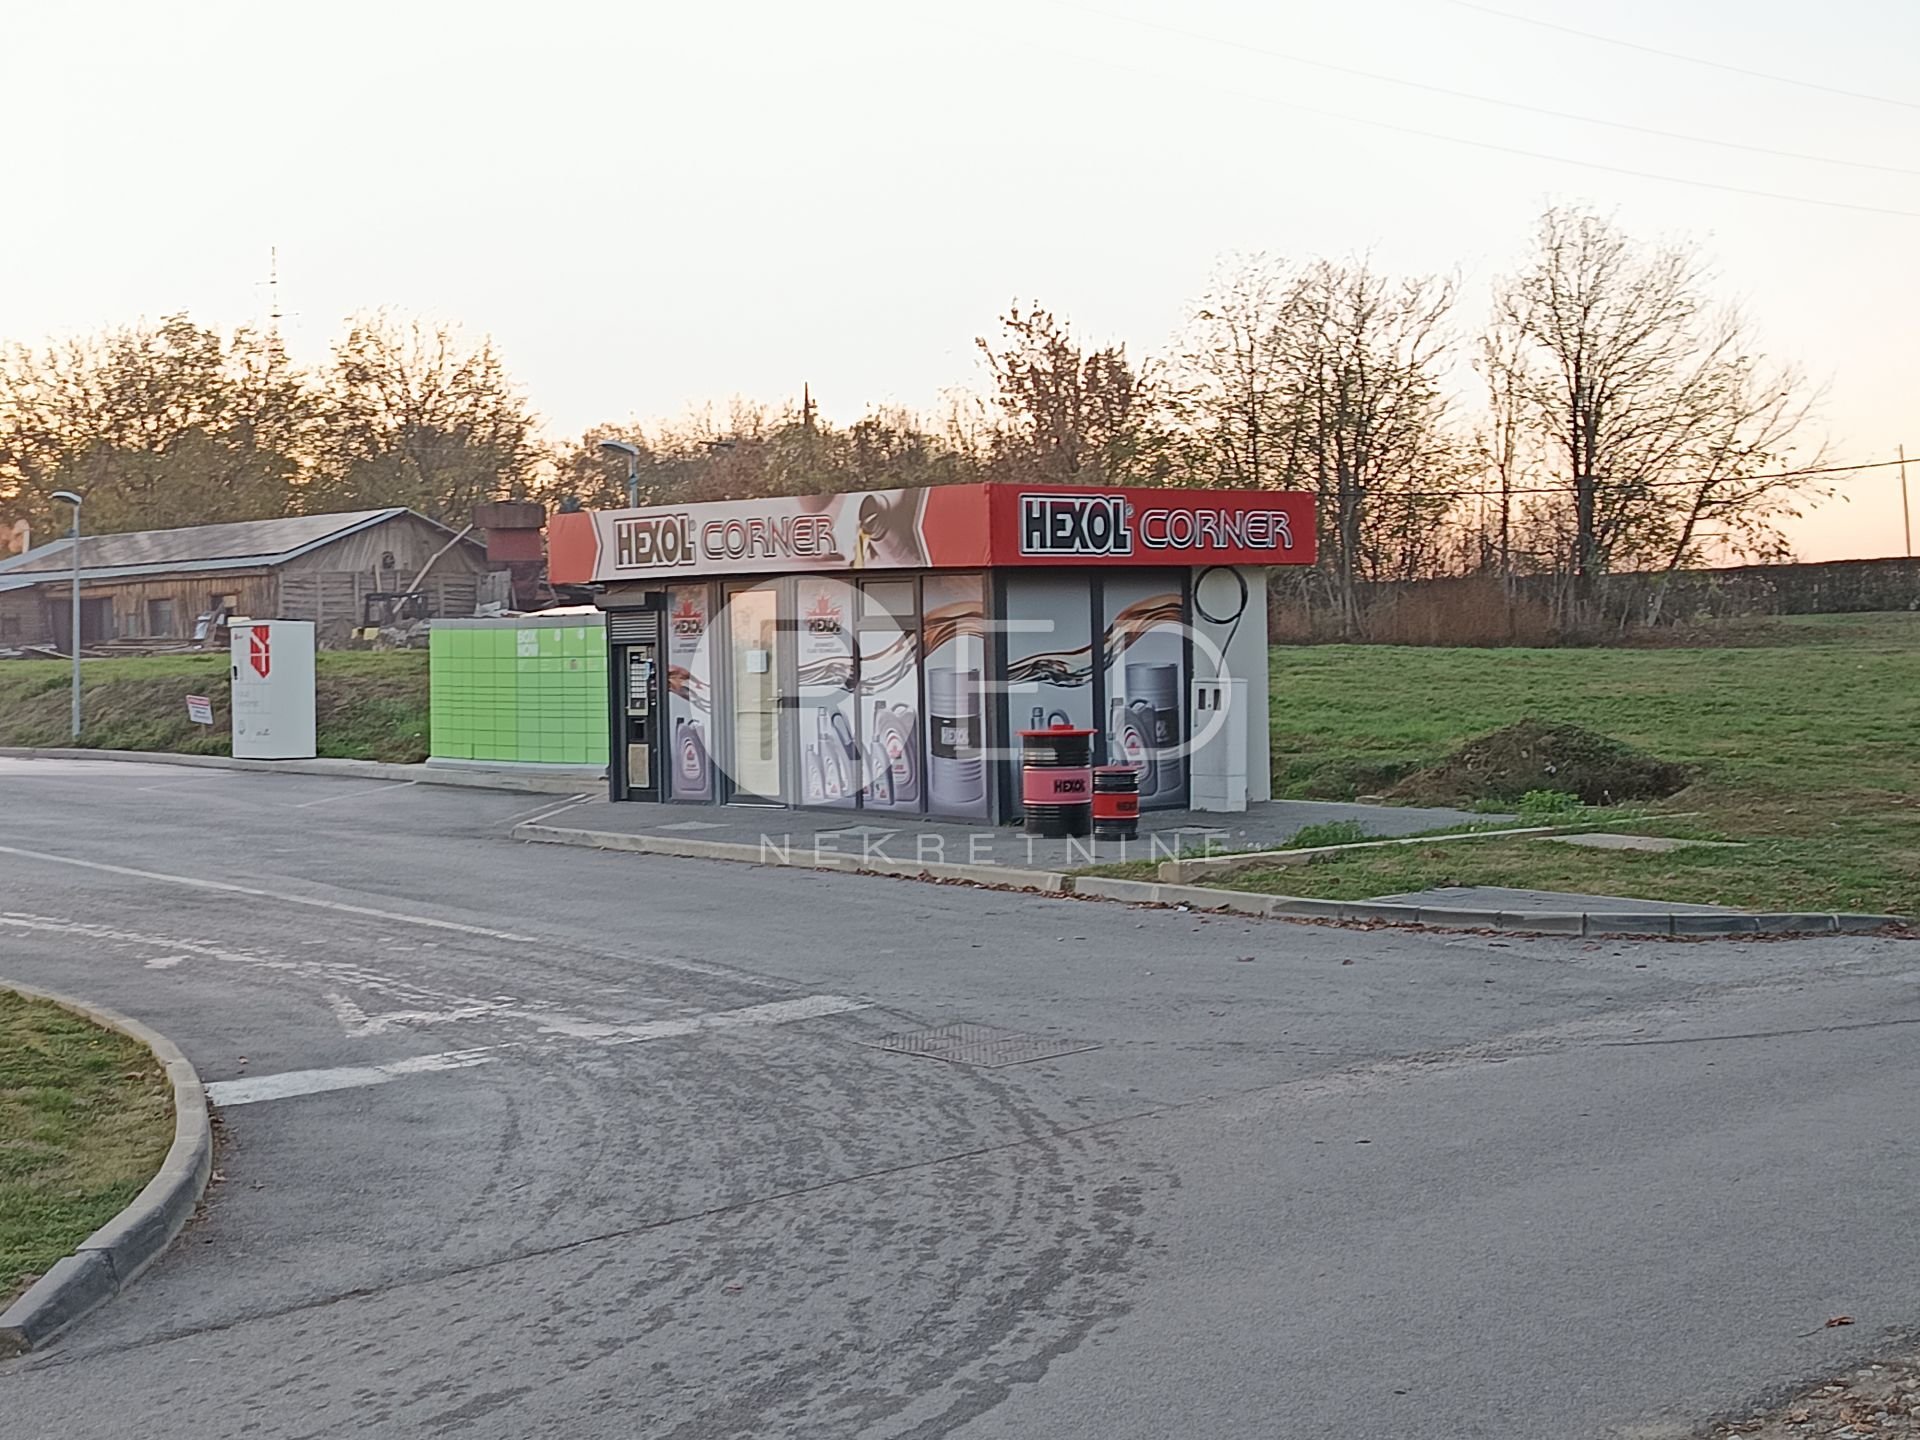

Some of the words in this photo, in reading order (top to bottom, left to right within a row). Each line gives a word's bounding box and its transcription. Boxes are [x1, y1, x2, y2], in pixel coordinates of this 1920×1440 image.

[616, 514, 695, 569] HEXOL
[701, 514, 838, 560] CORNER
[1022, 496, 1132, 555] HEXOL
[1140, 509, 1293, 550] CORNER
[1053, 779, 1086, 794] HEXOL
